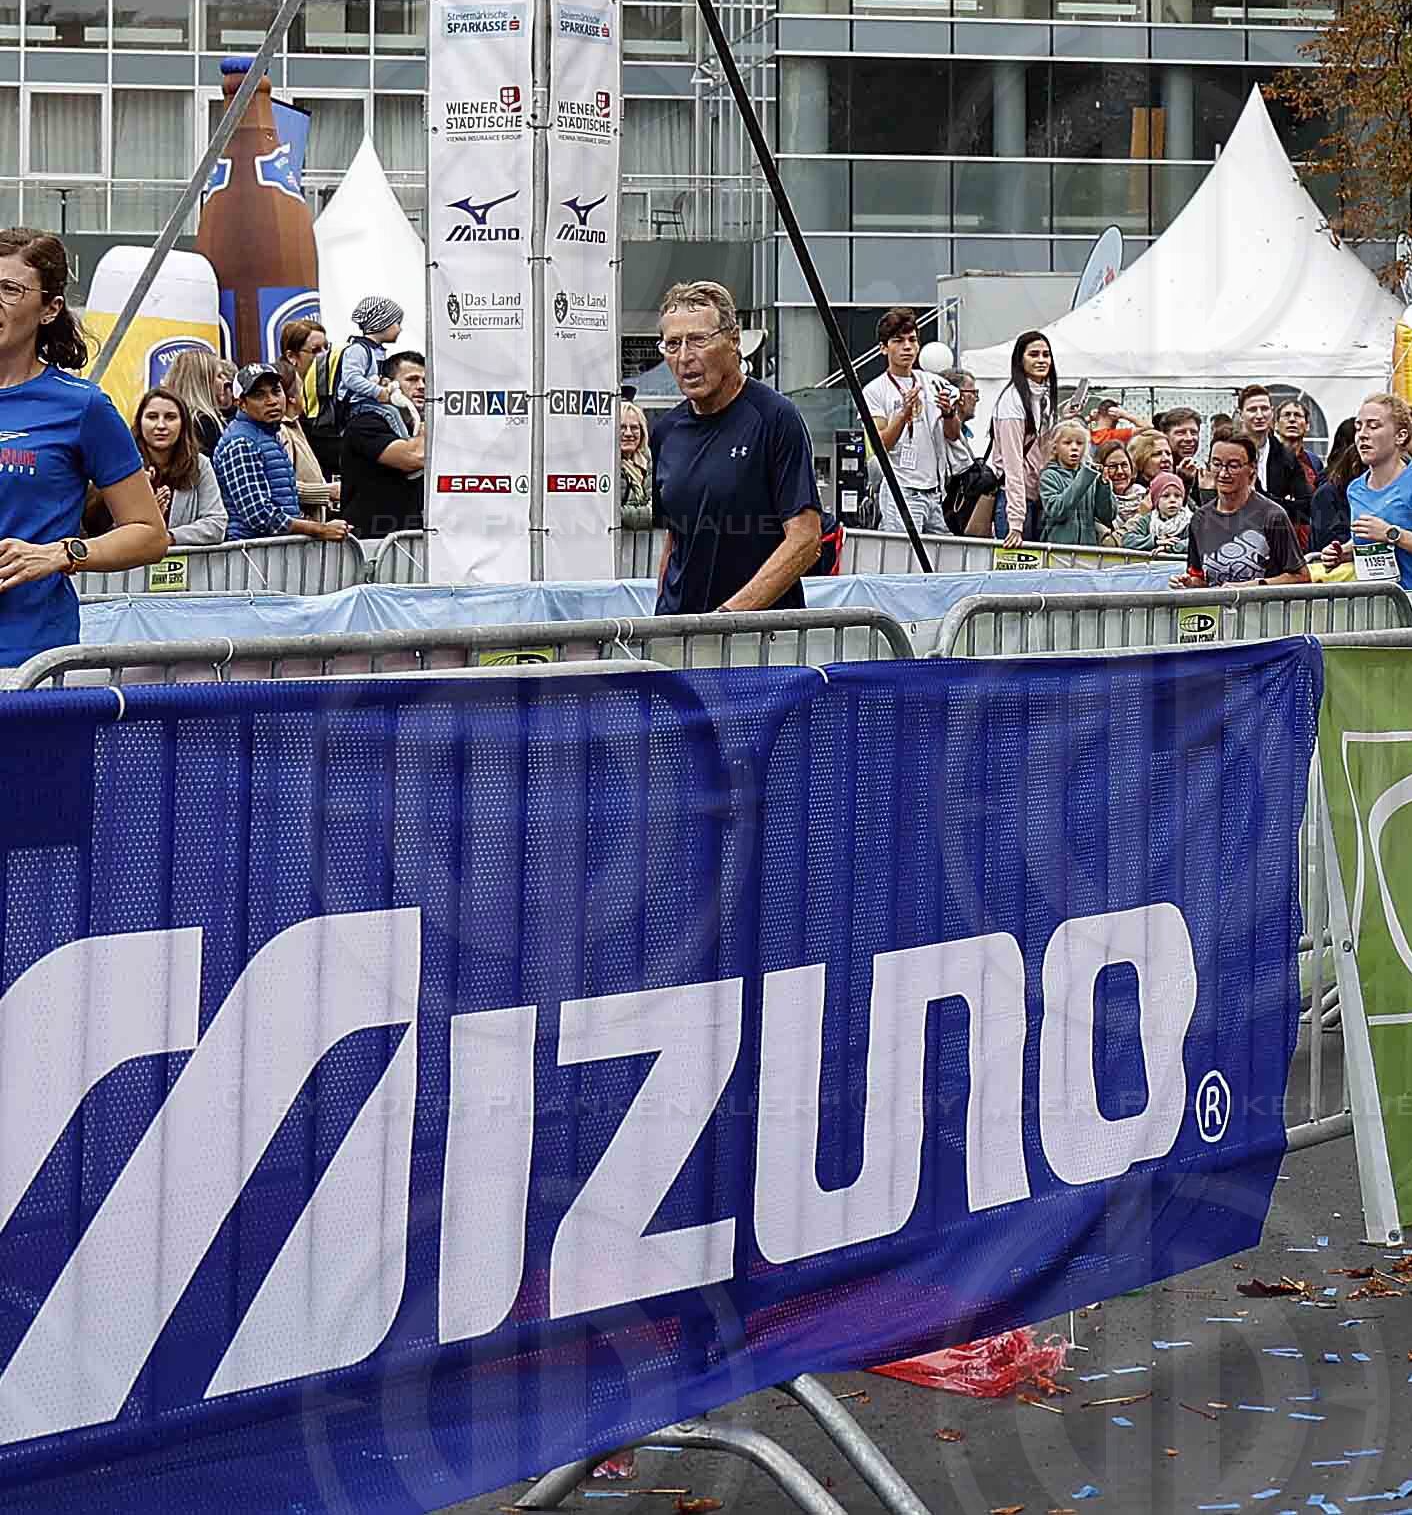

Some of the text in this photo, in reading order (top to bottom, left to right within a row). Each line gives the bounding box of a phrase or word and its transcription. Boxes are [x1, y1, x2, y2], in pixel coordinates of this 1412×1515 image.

[446, 20, 508, 35] SPARKASSE
[559, 19, 602, 39] SPARKASSE
[445, 100, 498, 116] WIENER
[557, 100, 596, 116] WIENER
[445, 114, 523, 131] STÄDTISCHE
[556, 114, 612, 134] STÄDTISCHE
[444, 224, 520, 243] MIZUNO
[555, 223, 608, 245] MIZUNO
[463, 290, 522, 308] Das Land
[571, 292, 607, 309] Das Land
[462, 313, 522, 329] Steiermark
[446, 392, 526, 416] GRAZ
[550, 391, 611, 416] GRAZ
[449, 477, 511, 492] SPAR
[556, 476, 597, 492] SPAR
[0, 902, 1199, 1442] MIZUNO
